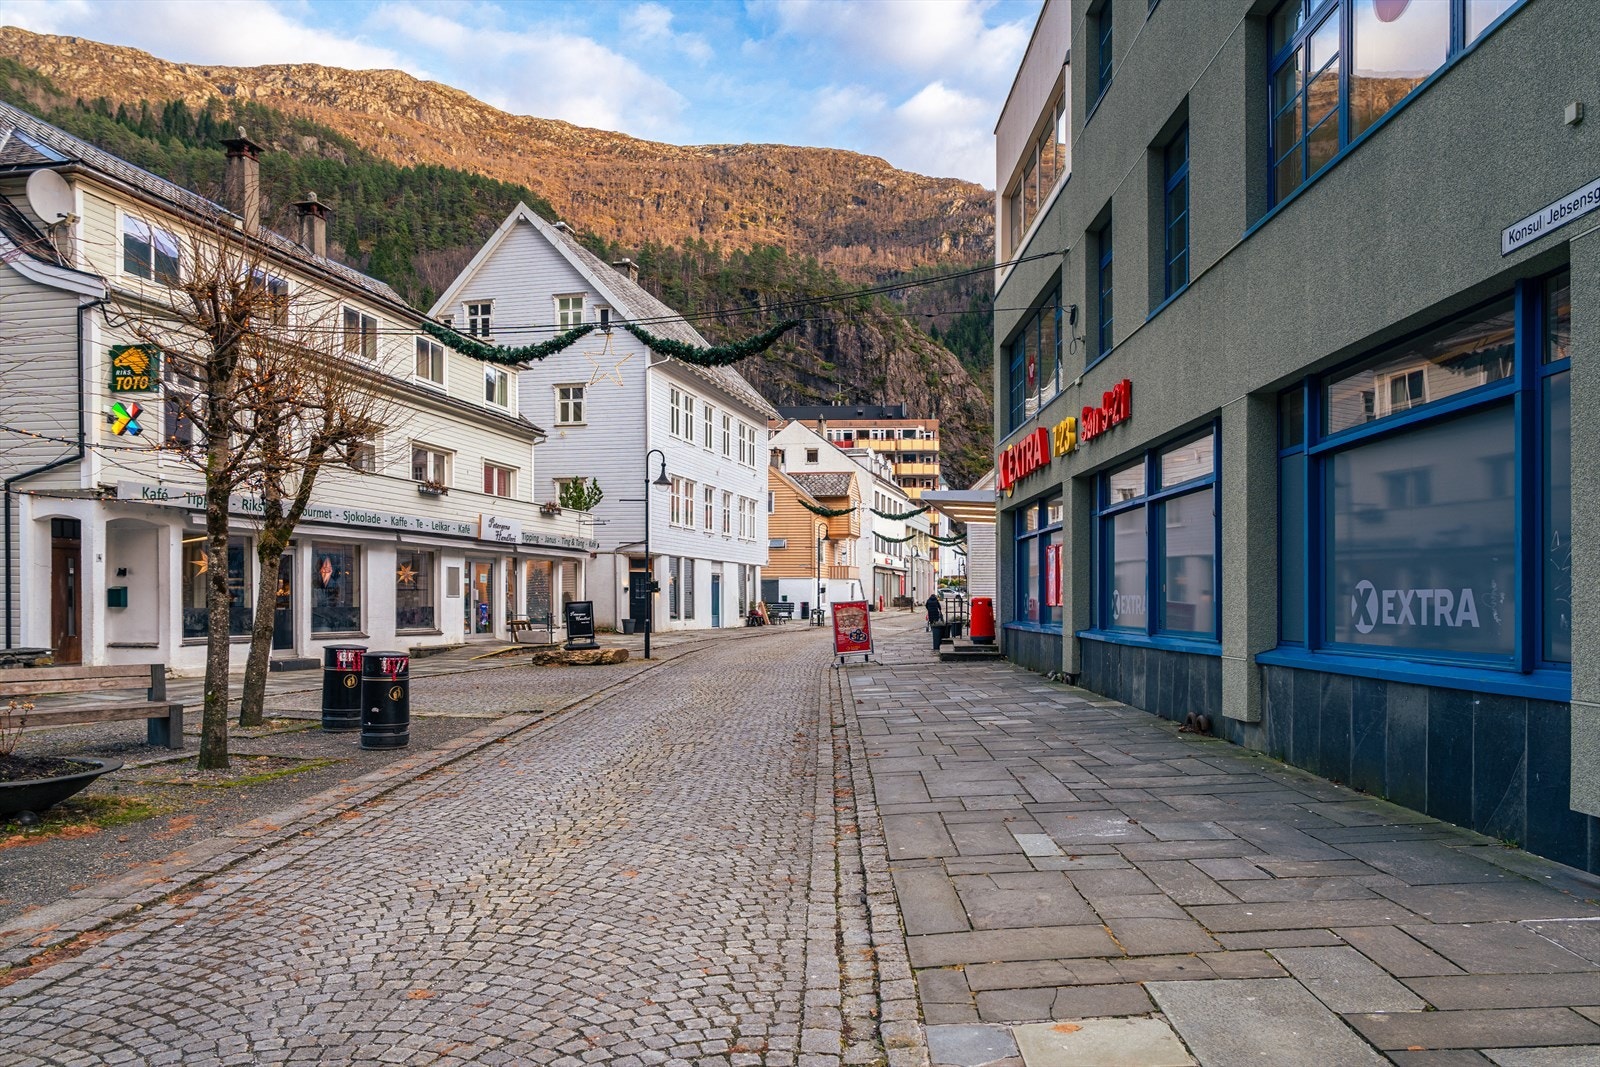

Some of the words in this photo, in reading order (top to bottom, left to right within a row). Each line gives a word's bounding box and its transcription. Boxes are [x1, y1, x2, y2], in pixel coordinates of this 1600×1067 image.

[1508, 215, 1542, 245] Konsul
[116, 376, 149, 390] TOTO
[1008, 427, 1047, 484] EXTRA
[142, 487, 169, 502] Kafé
[302, 508, 332, 520] ourmet
[343, 510, 381, 524] Sjokolade
[390, 516, 408, 528] Kaffe
[416, 519, 424, 529] Te
[431, 521, 450, 532] Leikar
[458, 524, 471, 534] Kafé
[521, 532, 539, 544] Tipping
[1382, 588, 1480, 628] EXTRA
